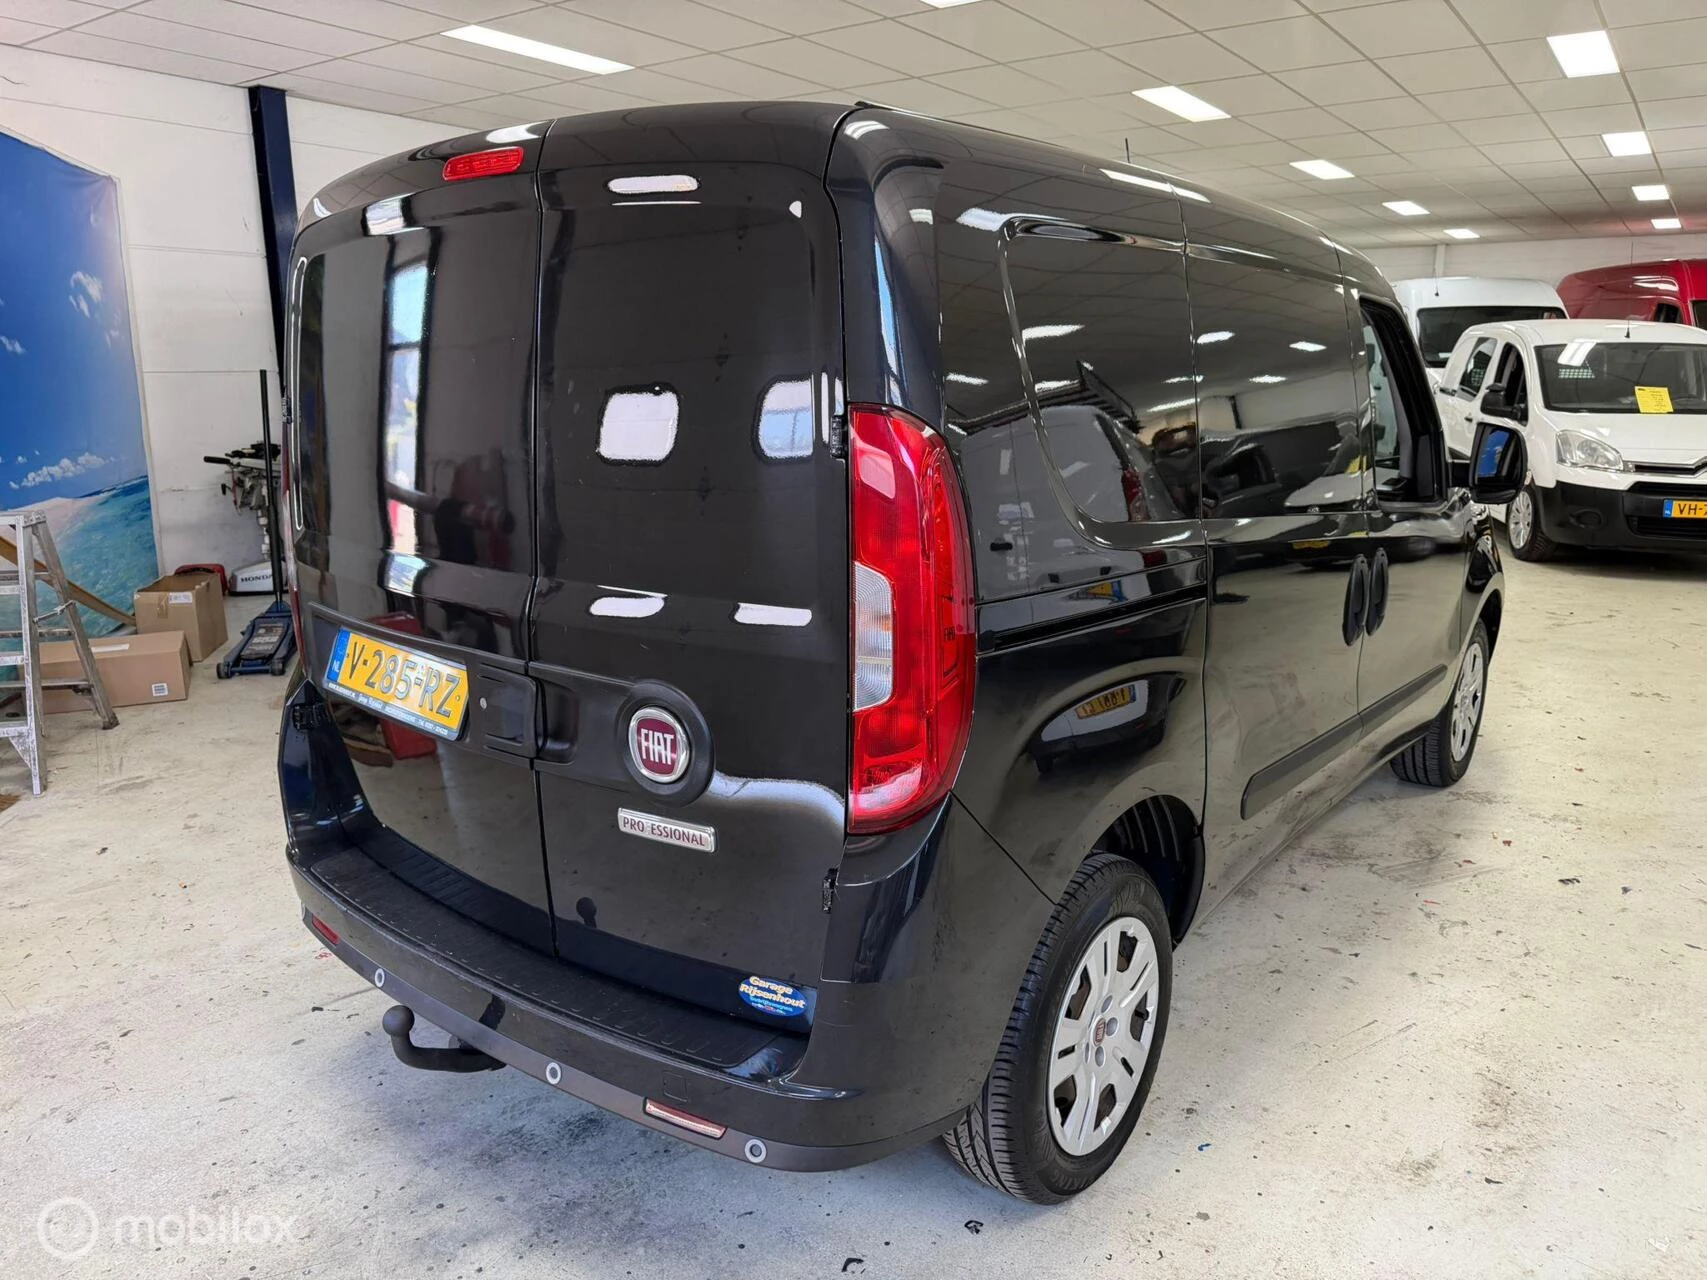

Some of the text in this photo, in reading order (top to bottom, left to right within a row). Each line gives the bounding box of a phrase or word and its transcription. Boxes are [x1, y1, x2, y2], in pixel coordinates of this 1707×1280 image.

[1677, 503, 1707, 516] VH-
[349, 641, 460, 718] V-285-RZ
[640, 728, 674, 765] FIAT
[623, 816, 705, 847] PROESSIONAL
[739, 983, 806, 1008] Rijsenhout
[749, 976, 793, 994] Garage
